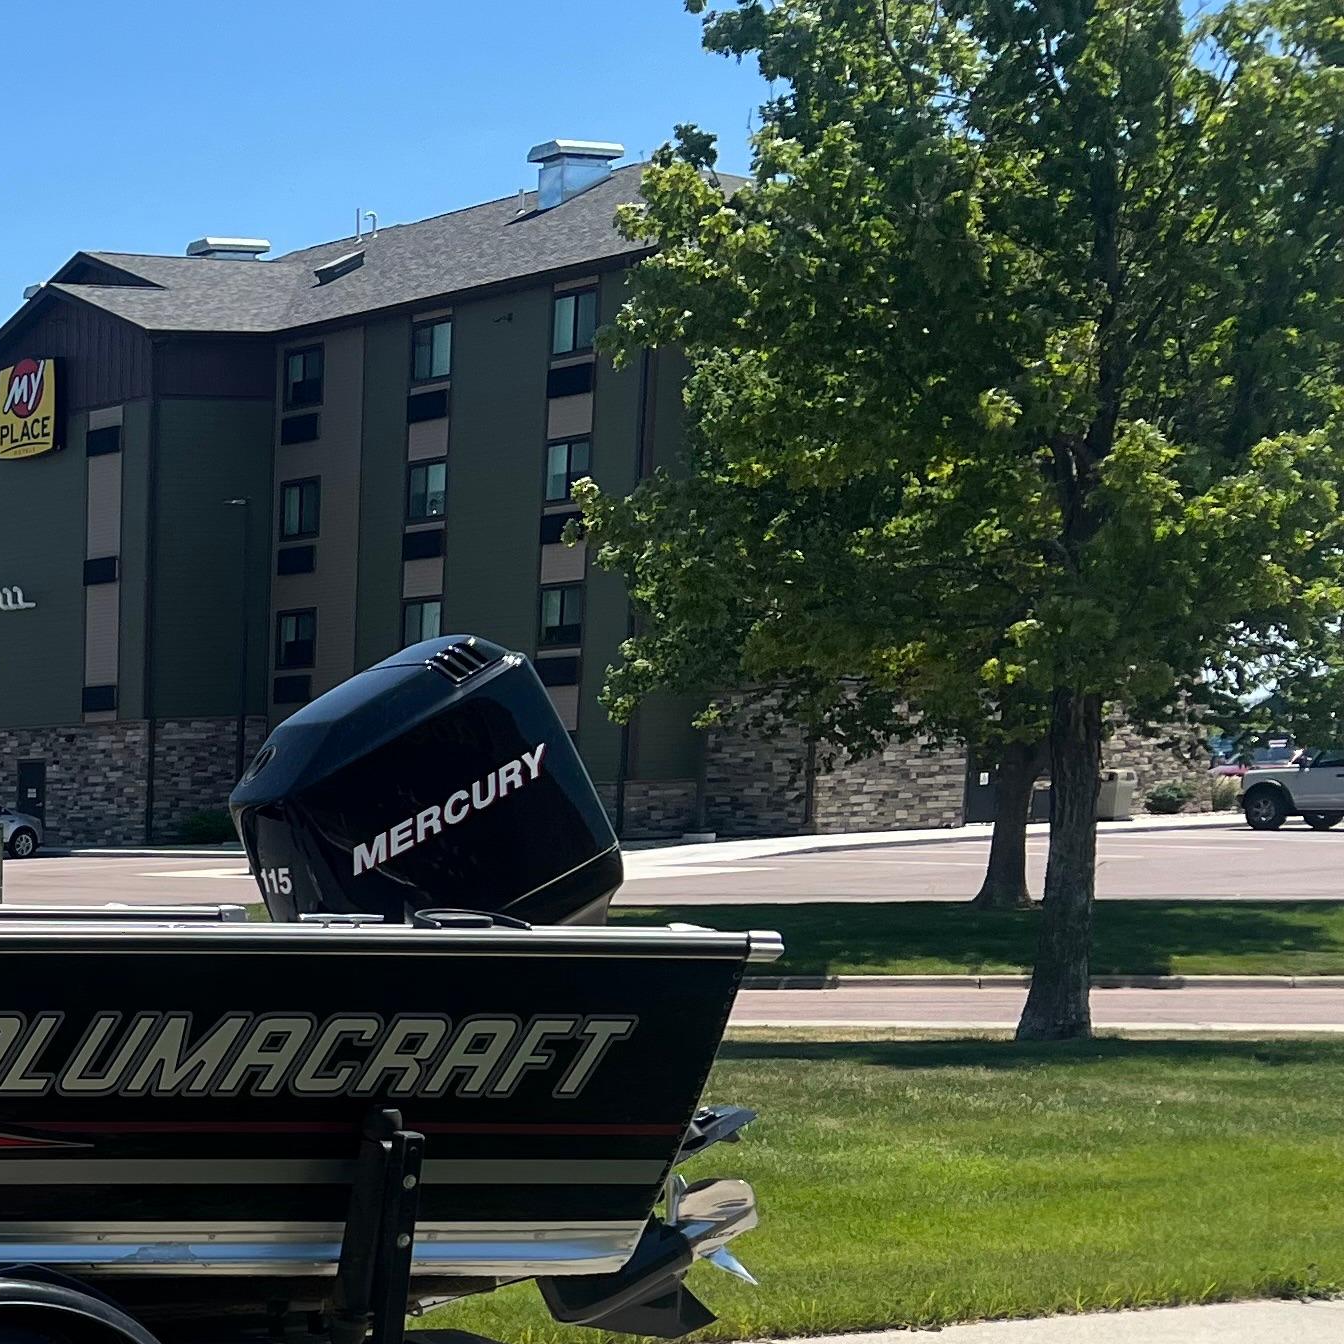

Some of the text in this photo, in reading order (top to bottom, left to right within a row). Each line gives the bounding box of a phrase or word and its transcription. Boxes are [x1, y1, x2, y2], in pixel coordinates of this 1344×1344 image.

[3, 359, 45, 413] MY
[0, 416, 51, 446] PLACE
[353, 743, 547, 876] MERCURY
[260, 867, 293, 896] 115
